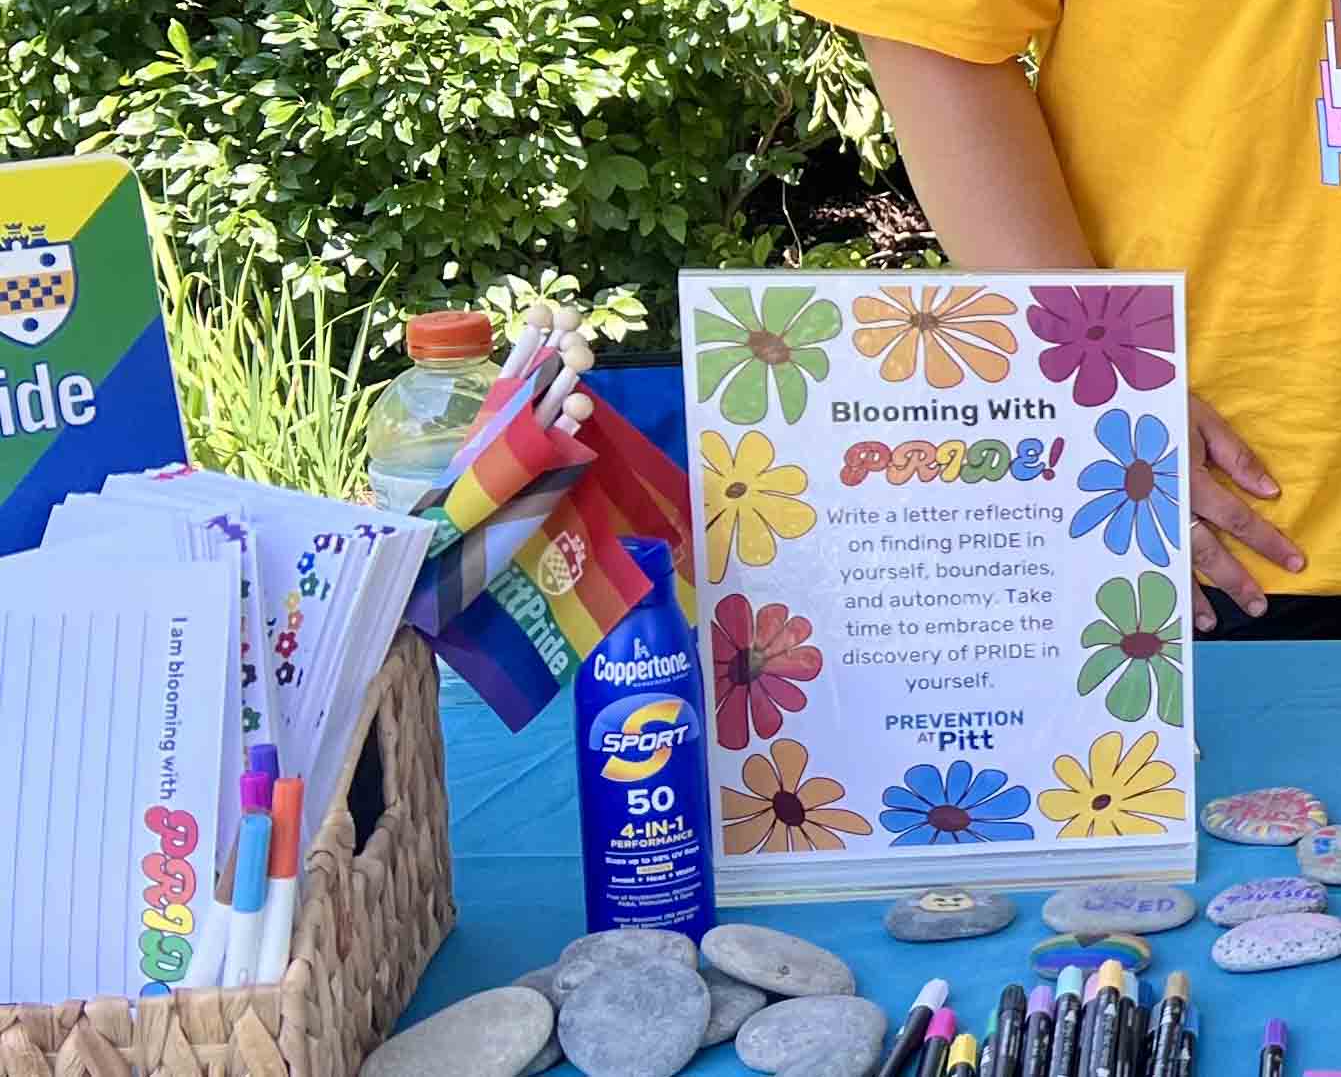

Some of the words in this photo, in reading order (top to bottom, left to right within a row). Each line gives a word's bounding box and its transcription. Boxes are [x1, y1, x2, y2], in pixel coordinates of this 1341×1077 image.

[0, 362, 96, 436] ide
[832, 400, 978, 426] Blooming
[988, 397, 1056, 420] With
[840, 437, 1064, 486] PRIDE!
[827, 507, 880, 524] Write
[886, 510, 897, 522] a
[903, 507, 960, 523] letter
[965, 504, 1063, 523] reflecting
[849, 539, 874, 553] on
[880, 535, 952, 554] finding
[959, 532, 1021, 550] PRIDE
[1027, 531, 1045, 548] in
[840, 562, 930, 584] yourself,
[935, 560, 1055, 579] boundaries,
[844, 593, 883, 609] and
[889, 590, 1000, 609] autonomy.
[1005, 588, 1053, 604] Take
[487, 567, 569, 676] ittPride
[845, 620, 892, 637] time
[897, 620, 919, 635] to
[925, 617, 1015, 635] embrace
[1020, 614, 1054, 632] the
[168, 628, 184, 657] am
[842, 647, 942, 665] discovery
[947, 644, 969, 662] of
[974, 643, 1036, 660] PRIDE
[1042, 642, 1060, 659] in
[594, 652, 689, 686] Coppertone
[905, 672, 995, 693] yourself.
[158, 661, 185, 751] blooming
[885, 710, 1024, 731] PREVENTION
[602, 725, 689, 753] SPORT
[917, 731, 936, 744] AT
[938, 729, 994, 752] Pitt
[159, 756, 178, 800] with
[627, 785, 675, 815] 50
[610, 829, 694, 849] PERFORMANCE
[620, 815, 684, 839] 4-IN-1
